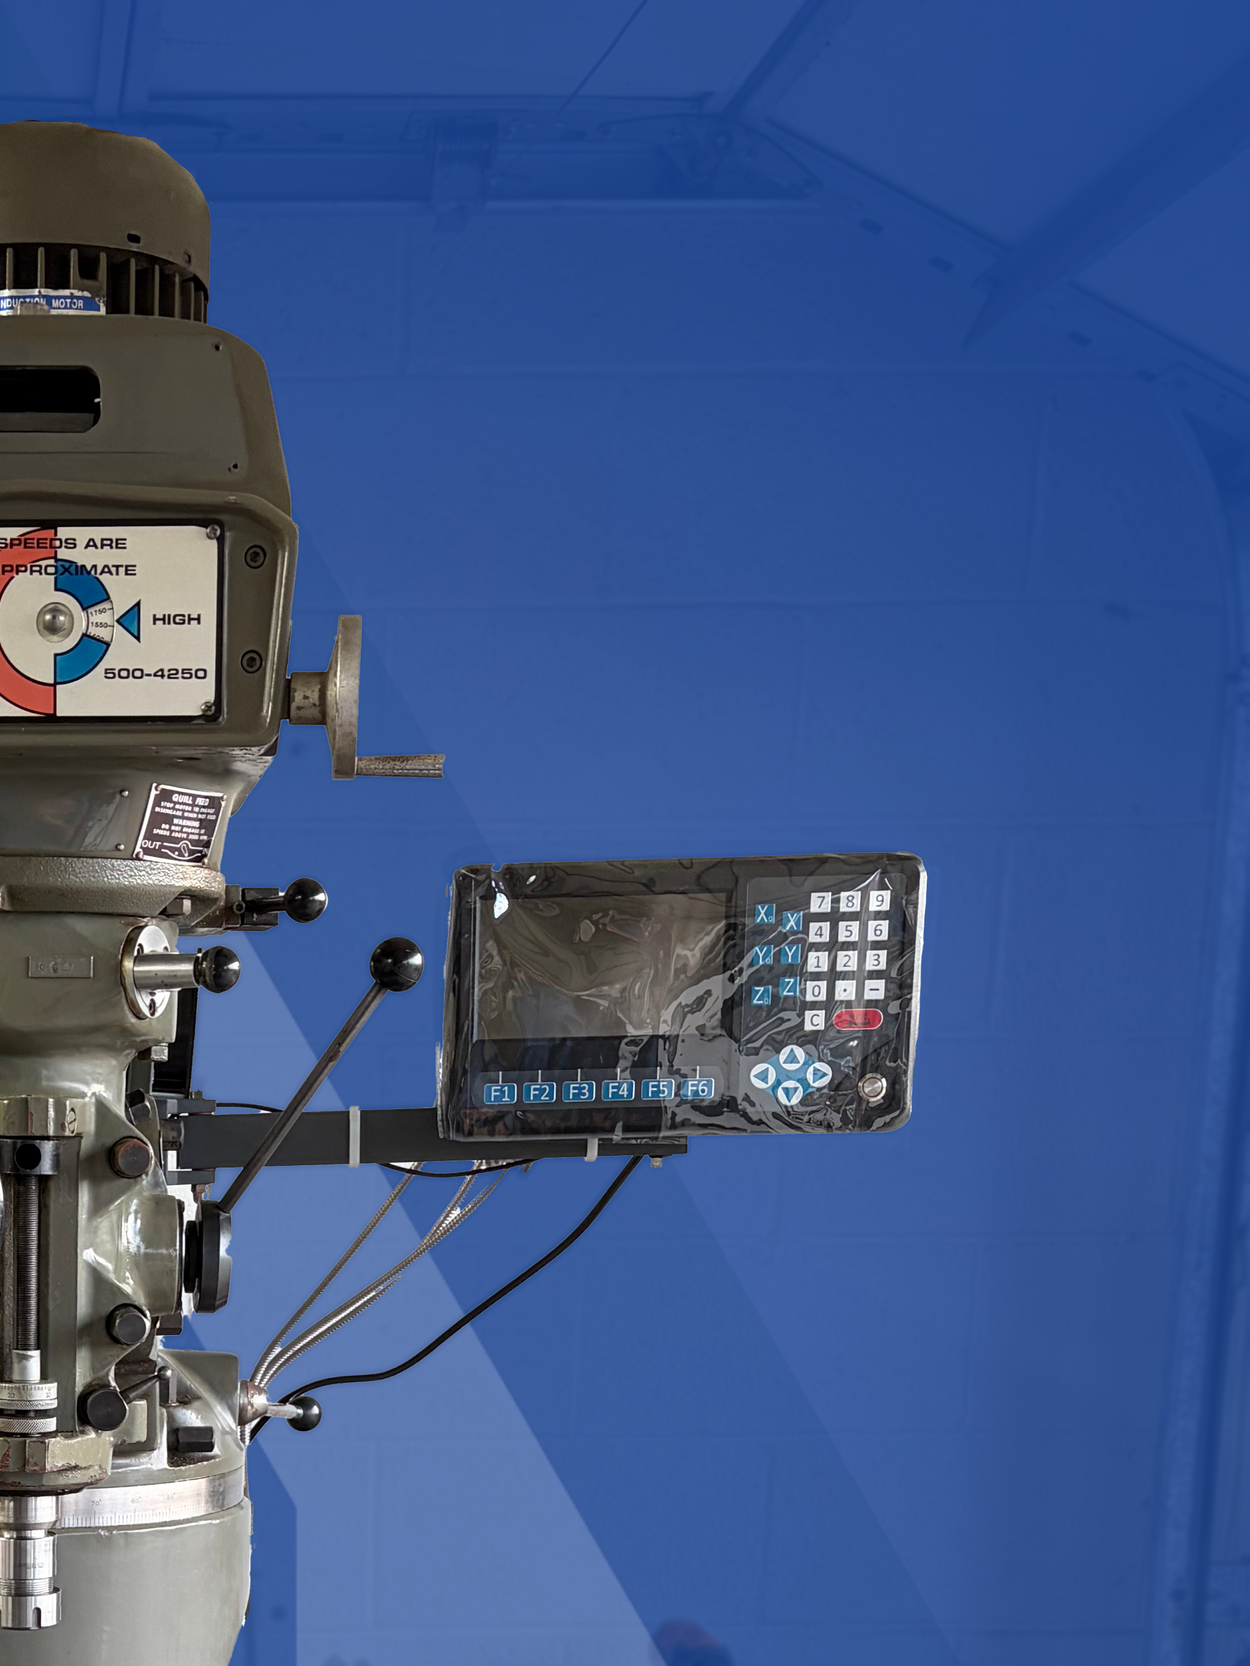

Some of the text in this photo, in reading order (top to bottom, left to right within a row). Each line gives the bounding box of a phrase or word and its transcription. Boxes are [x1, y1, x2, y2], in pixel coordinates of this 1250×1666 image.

[52, 298, 84, 309] MOTOR
[84, 537, 127, 550] ARE
[90, 607, 107, 617] 1750
[91, 621, 108, 629] 1550
[152, 613, 201, 625] HIGH
[104, 668, 207, 679] 500-4250
[172, 793, 210, 806] QUILL FEED
[155, 806, 183, 816] DISENGAGE
[173, 818, 200, 828] WARNING
[141, 839, 162, 850] OUT
[817, 894, 884, 909] 7 8 9
[785, 913, 797, 930] X
[814, 924, 883, 938] 4 5 6
[785, 946, 796, 962] Y
[814, 954, 881, 969] 1 2 3
[783, 979, 794, 995] Z
[811, 985, 821, 997] 0
[810, 1013, 820, 1027] C
[491, 1081, 707, 1101] F1 F2 F3 F4 F5 F6
